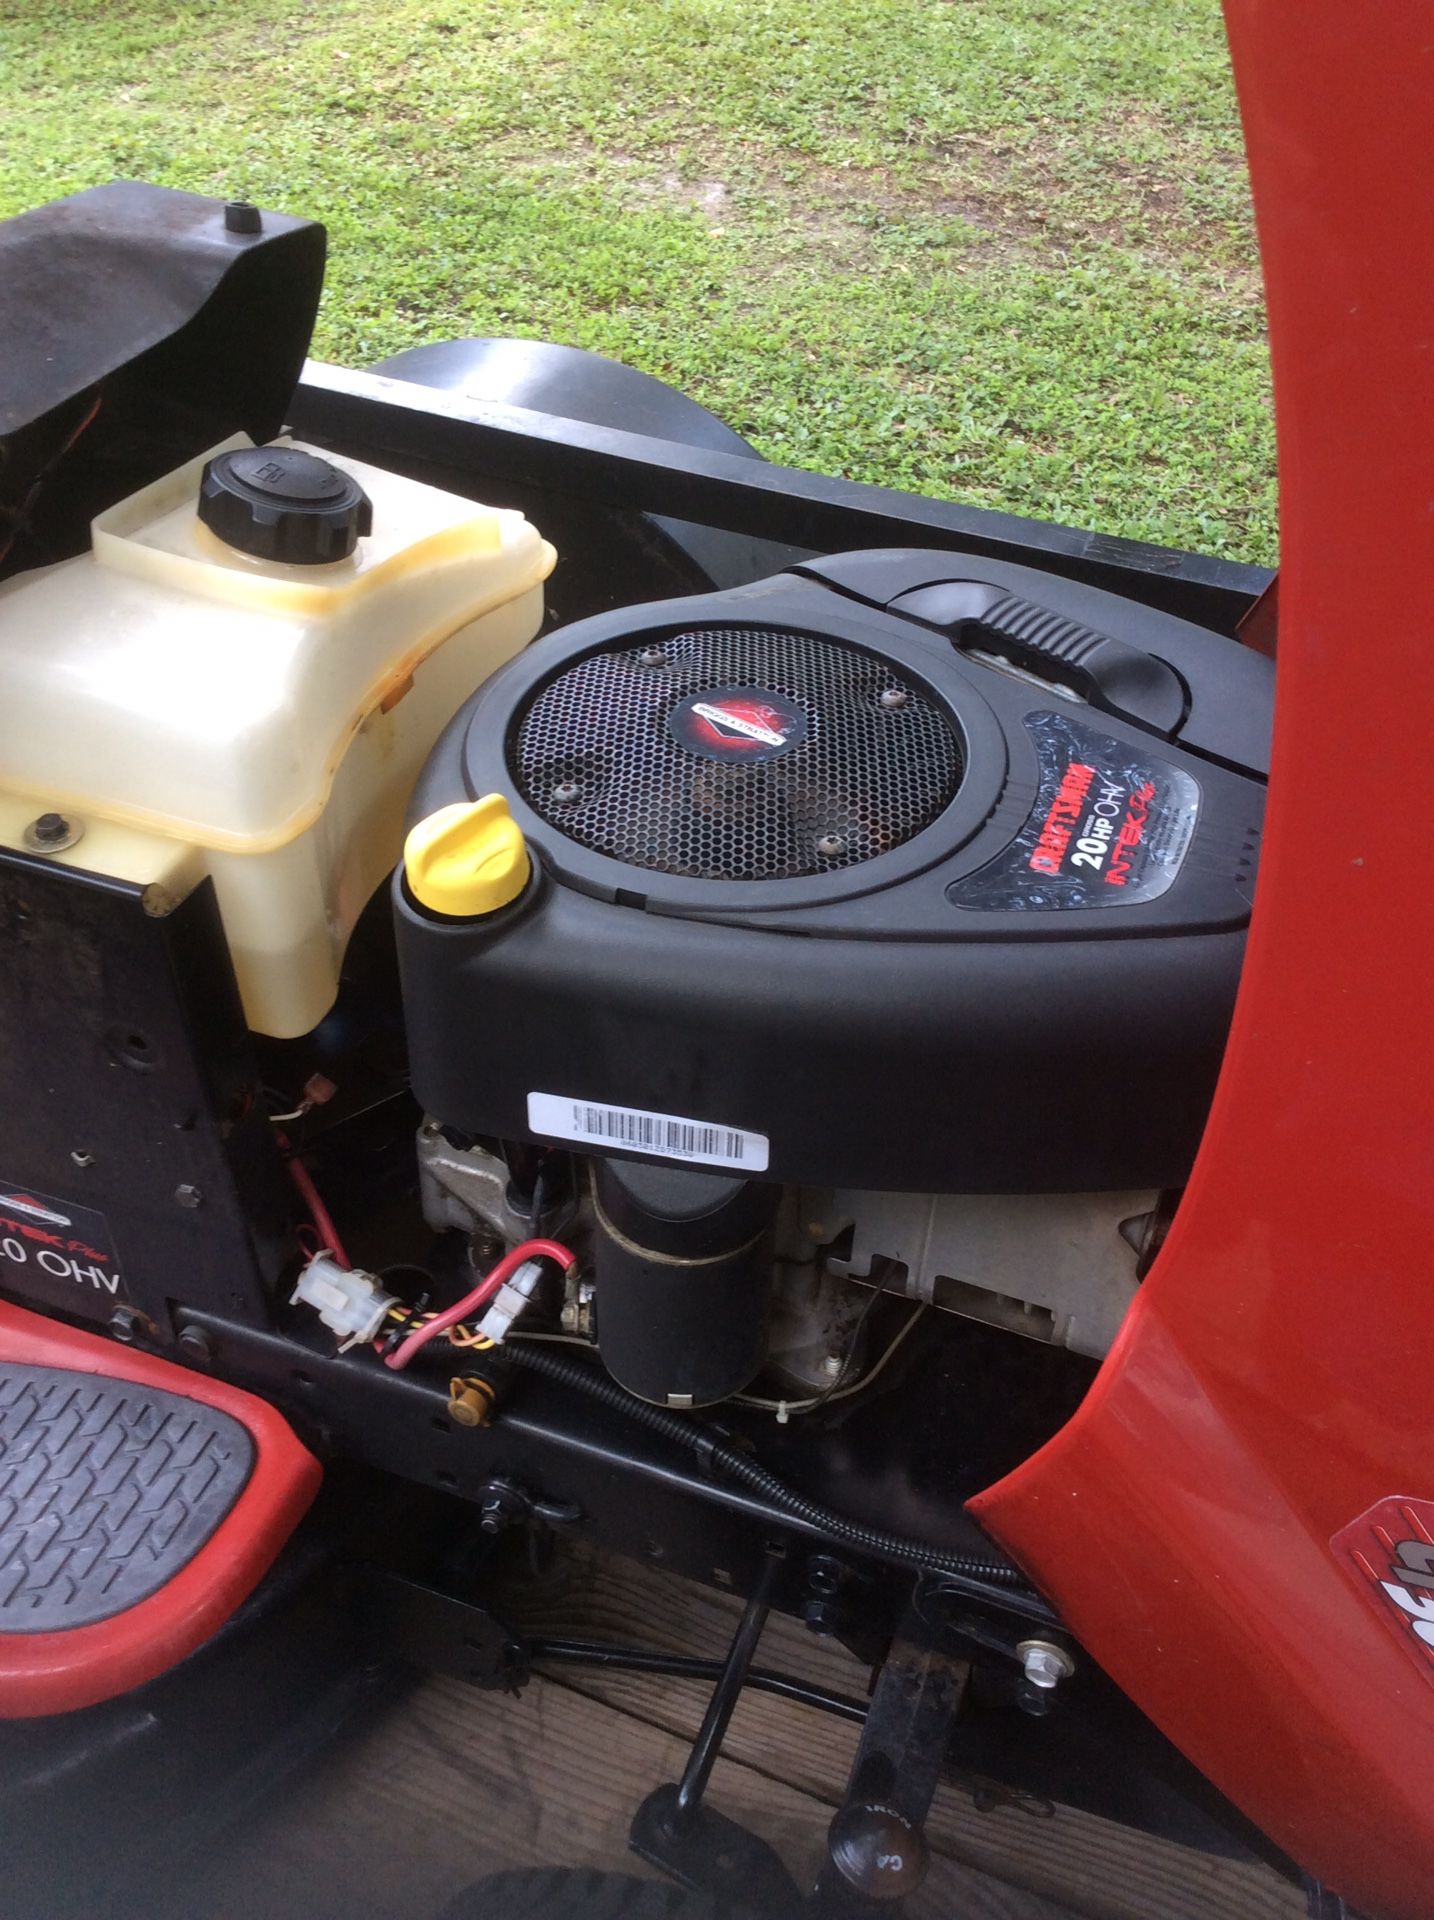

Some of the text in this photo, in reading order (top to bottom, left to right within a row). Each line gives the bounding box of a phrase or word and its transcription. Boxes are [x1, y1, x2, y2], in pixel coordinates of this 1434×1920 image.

[738, 722, 779, 743] STRATTN
[1029, 762, 1096, 874] CRAFTSMAN
[1070, 778, 1126, 871] 20 HP OHV
[1104, 811, 1148, 887] INTEK
[0, 1217, 66, 1250] TEK
[0, 1238, 119, 1295] 0 OHV
